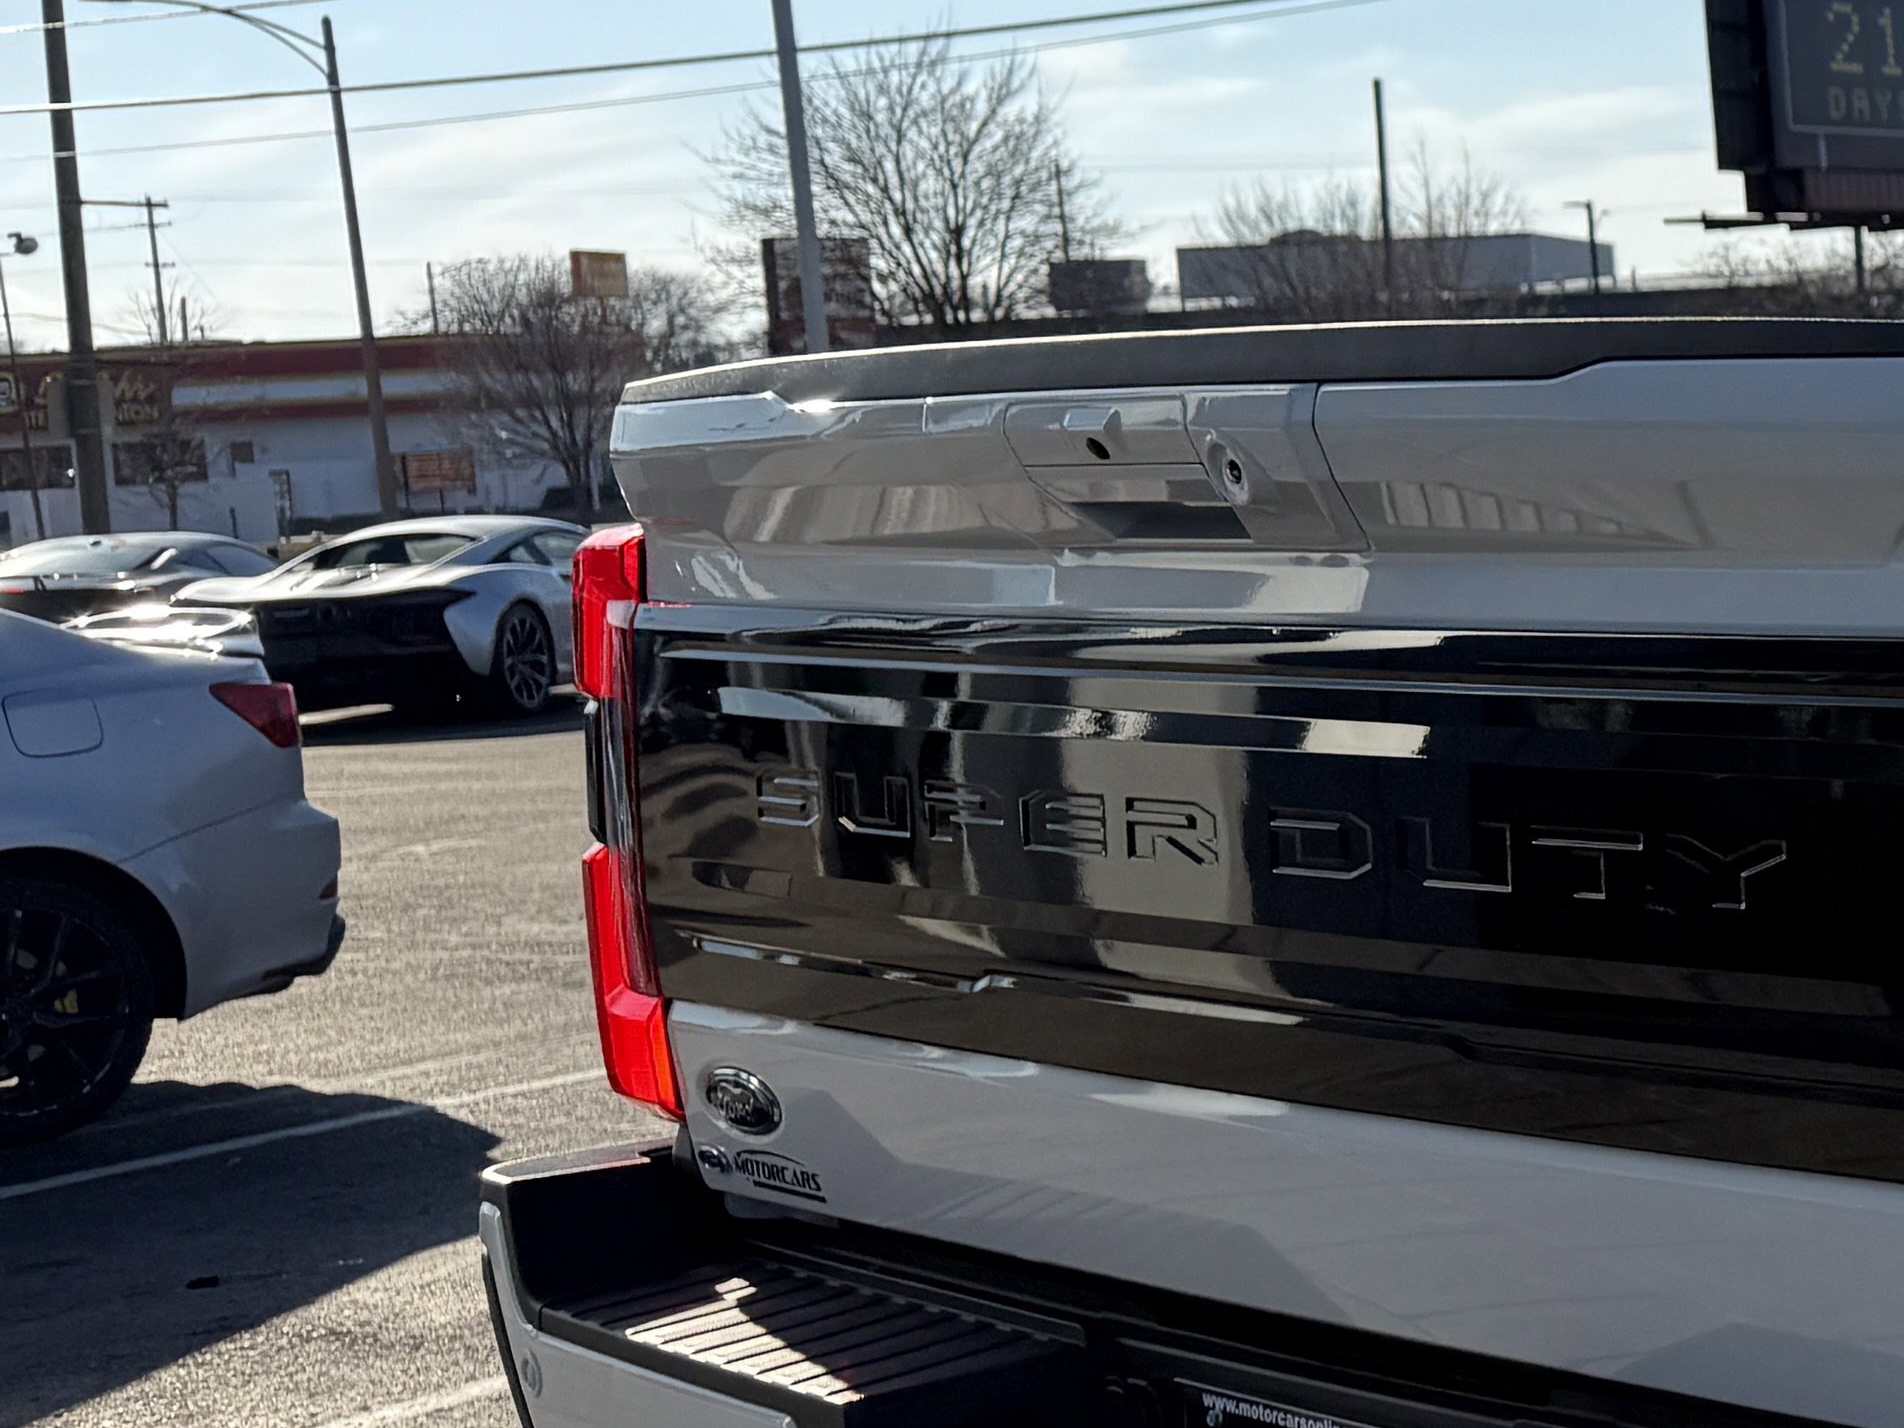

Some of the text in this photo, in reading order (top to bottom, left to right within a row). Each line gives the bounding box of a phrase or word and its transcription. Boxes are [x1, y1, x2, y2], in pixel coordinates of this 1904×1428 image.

[1828, 1, 1902, 75] 21
[754, 768, 1790, 912] SUPER DUTY
[733, 1153, 822, 1192] MOTORCARS
